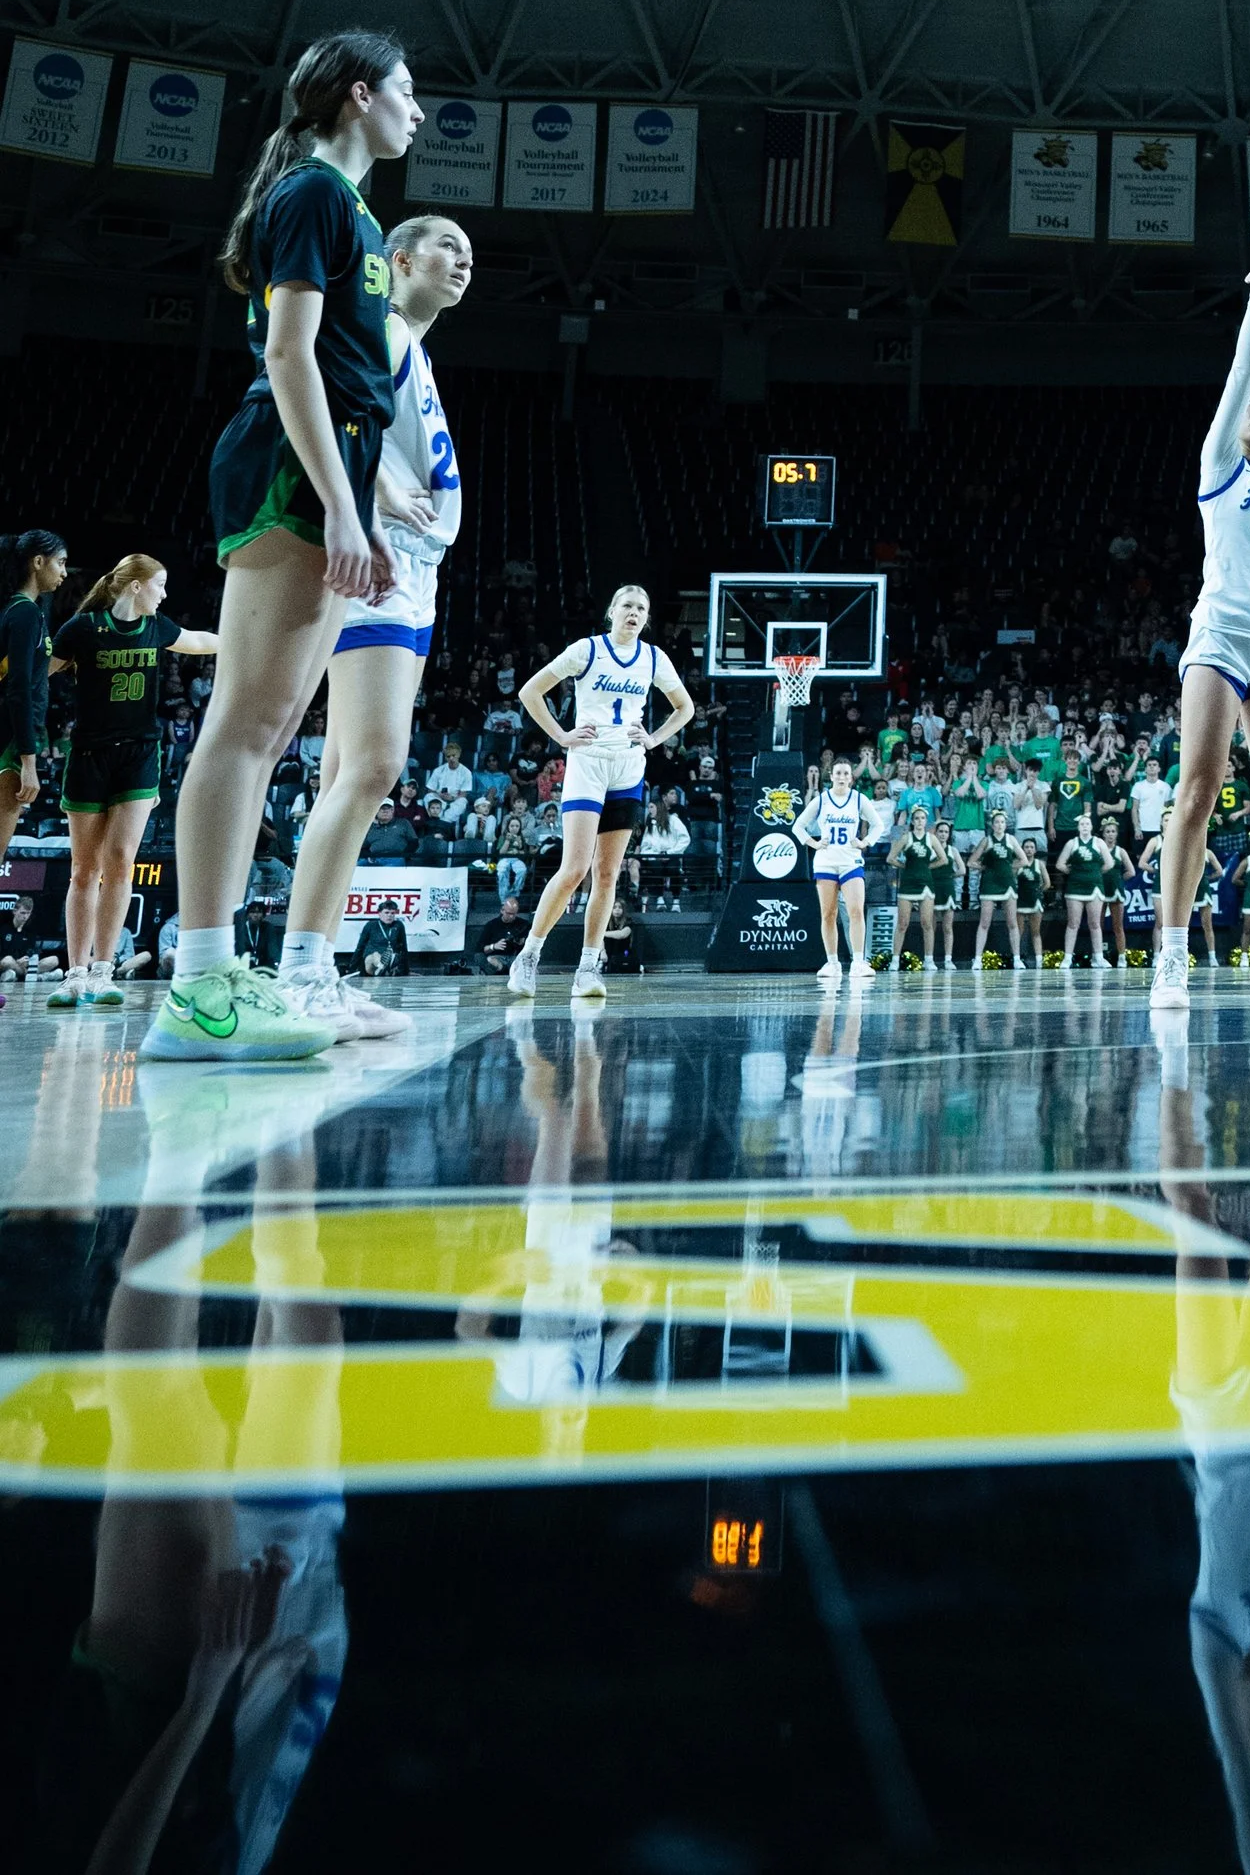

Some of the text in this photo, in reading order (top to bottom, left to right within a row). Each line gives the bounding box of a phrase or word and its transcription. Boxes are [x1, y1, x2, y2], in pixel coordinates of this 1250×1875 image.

[38, 73, 82, 90] NCAA
[153, 92, 197, 108] NCAA
[440, 119, 475, 132] NCAA
[536, 122, 571, 134] NCAA
[638, 126, 673, 137] NCAA
[27, 127, 70, 148] 2012
[145, 144, 189, 163] 2013
[425, 139, 485, 155] Volleyball
[415, 154, 491, 171] Tournament
[523, 149, 579, 162] Volleyball
[624, 152, 679, 165] Volleyball
[515, 160, 585, 171] Tournament
[617, 163, 685, 174] Tournament
[431, 182, 470, 198] 2016
[531, 187, 567, 202] 2017
[631, 188, 669, 204] 2024
[1036, 214, 1069, 229] 1964
[1136, 219, 1169, 233] 1965
[774, 462, 816, 483] 05.7
[96, 648, 158, 669] SOUTH
[110, 672, 145, 702] 20
[592, 674, 645, 695] Huskies
[612, 698, 623, 725] 1
[1221, 787, 1236, 808] S
[824, 813, 856, 825] Huskies
[829, 826, 848, 845] 15
[755, 842, 795, 865] Pella
[740, 930, 808, 943] DYNAMO
